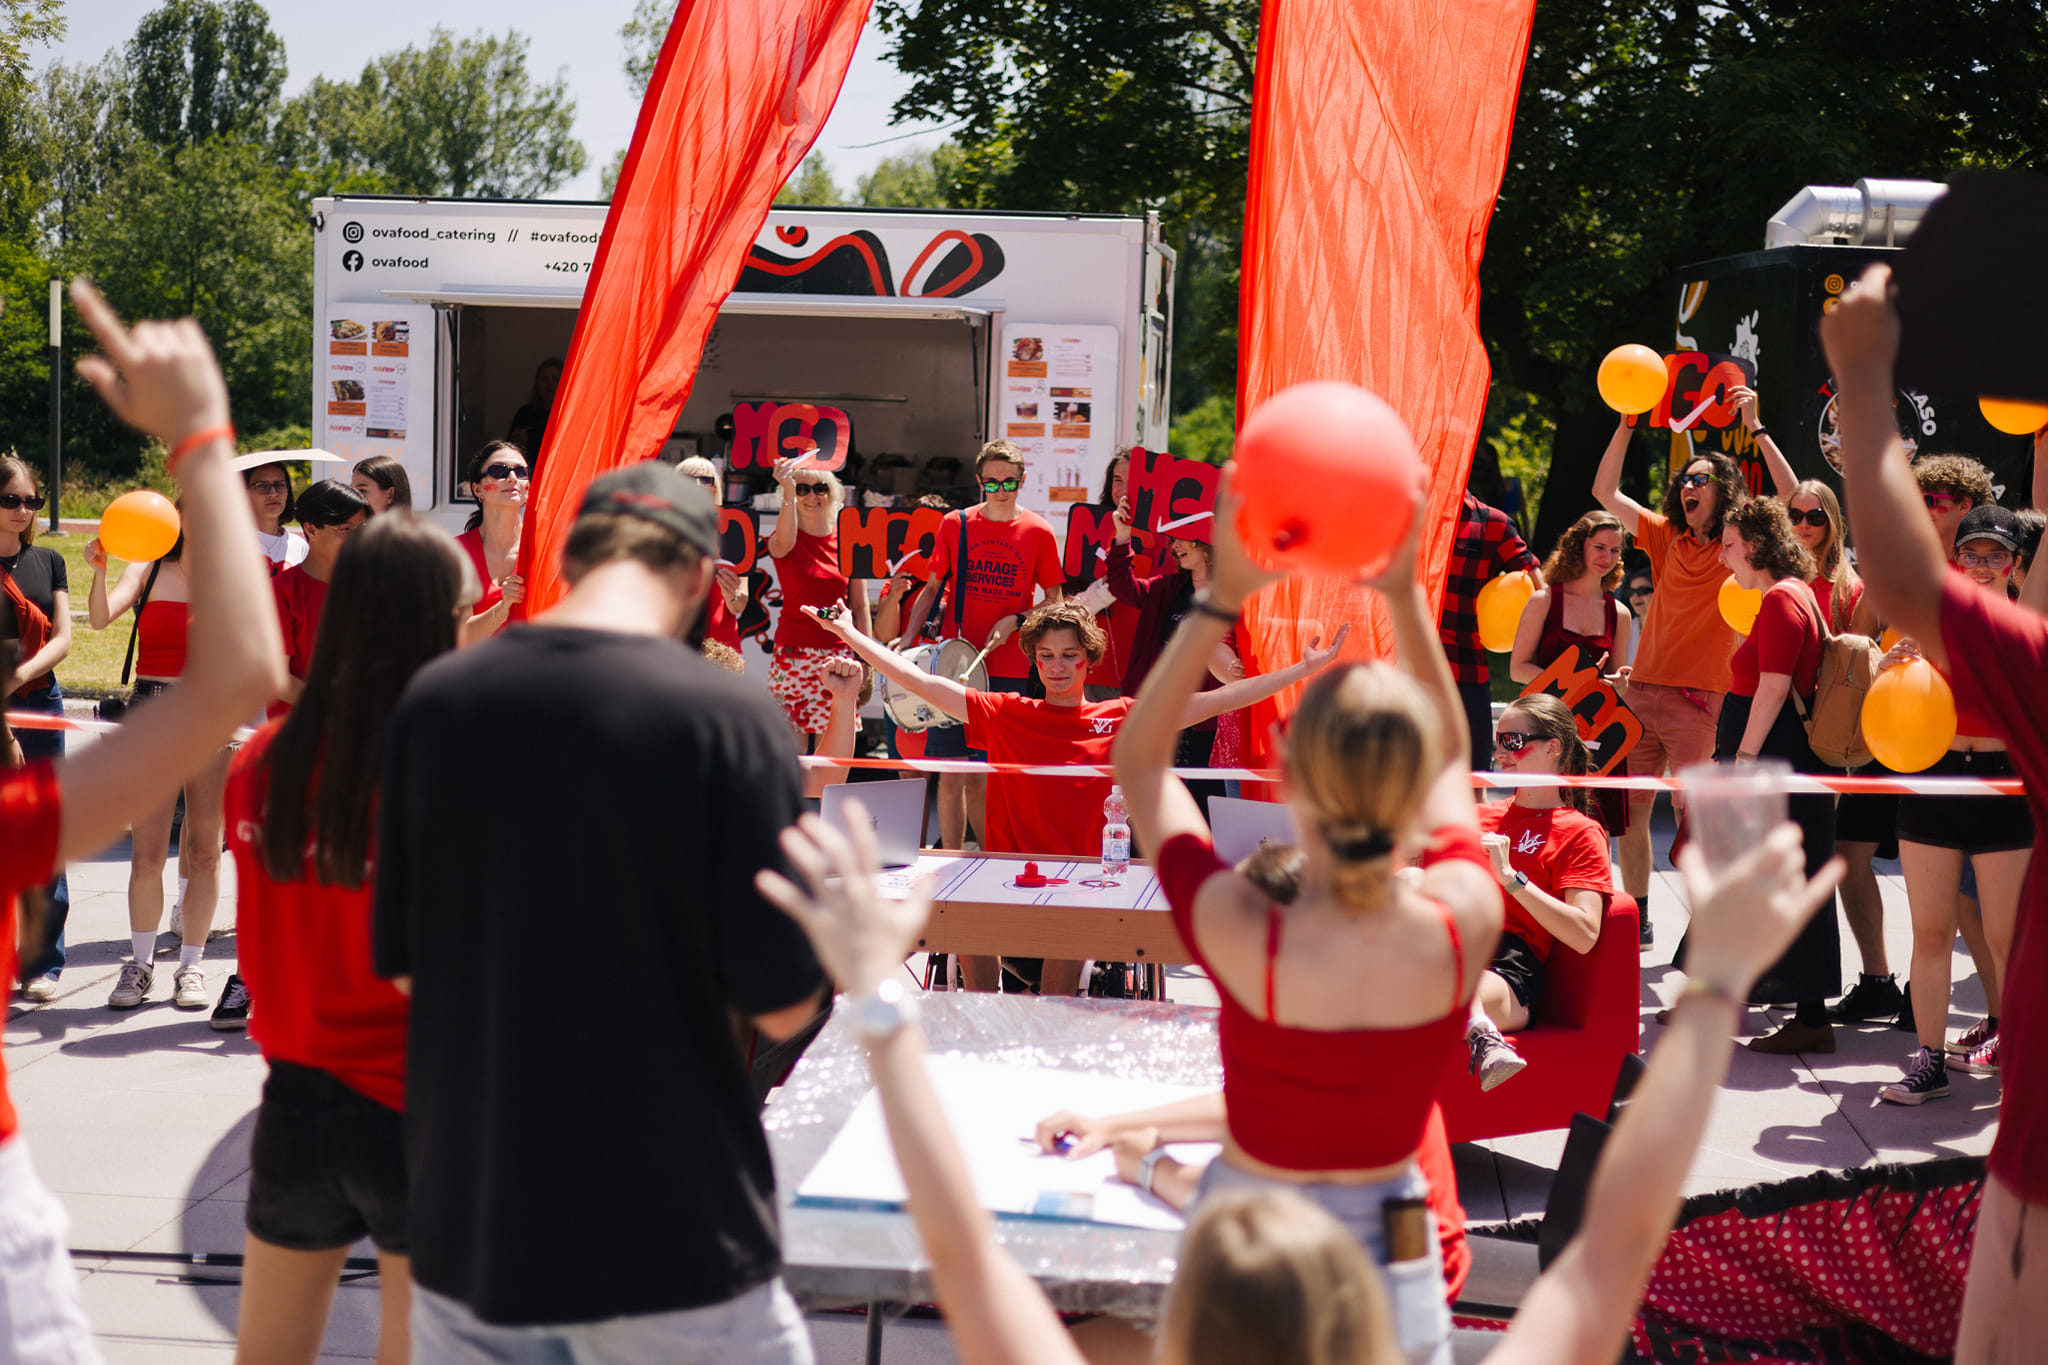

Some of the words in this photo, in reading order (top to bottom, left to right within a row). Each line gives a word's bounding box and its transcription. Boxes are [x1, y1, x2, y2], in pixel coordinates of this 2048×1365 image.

[372, 227, 496, 243] ovafood_catering
[531, 231, 601, 243] #ovafood
[372, 257, 429, 269] ovafood
[544, 262, 579, 273] +420
[1910, 390, 1937, 436] ASO
[967, 560, 1018, 576] GARAGE
[966, 572, 1015, 587] SERVICES
[982, 588, 1003, 596] MADE
